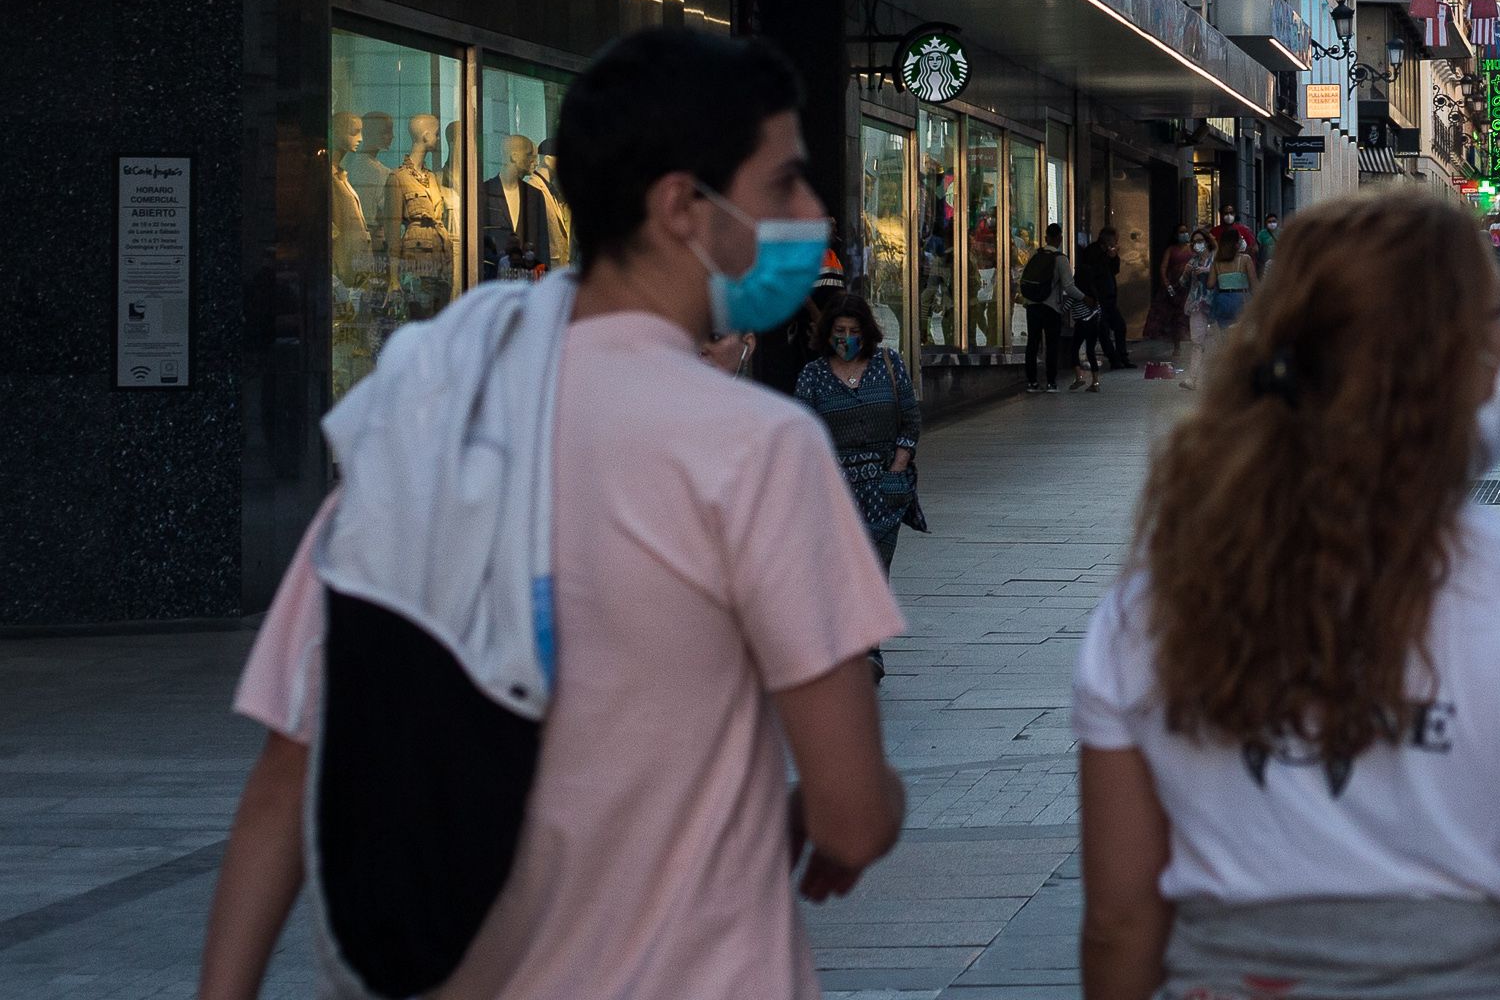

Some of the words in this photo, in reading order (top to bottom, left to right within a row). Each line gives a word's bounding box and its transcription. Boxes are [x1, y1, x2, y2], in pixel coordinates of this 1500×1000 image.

[136, 186, 174, 194] HORARIO
[130, 196, 180, 204] COMERCIAL
[131, 208, 176, 218] ABIERTO
